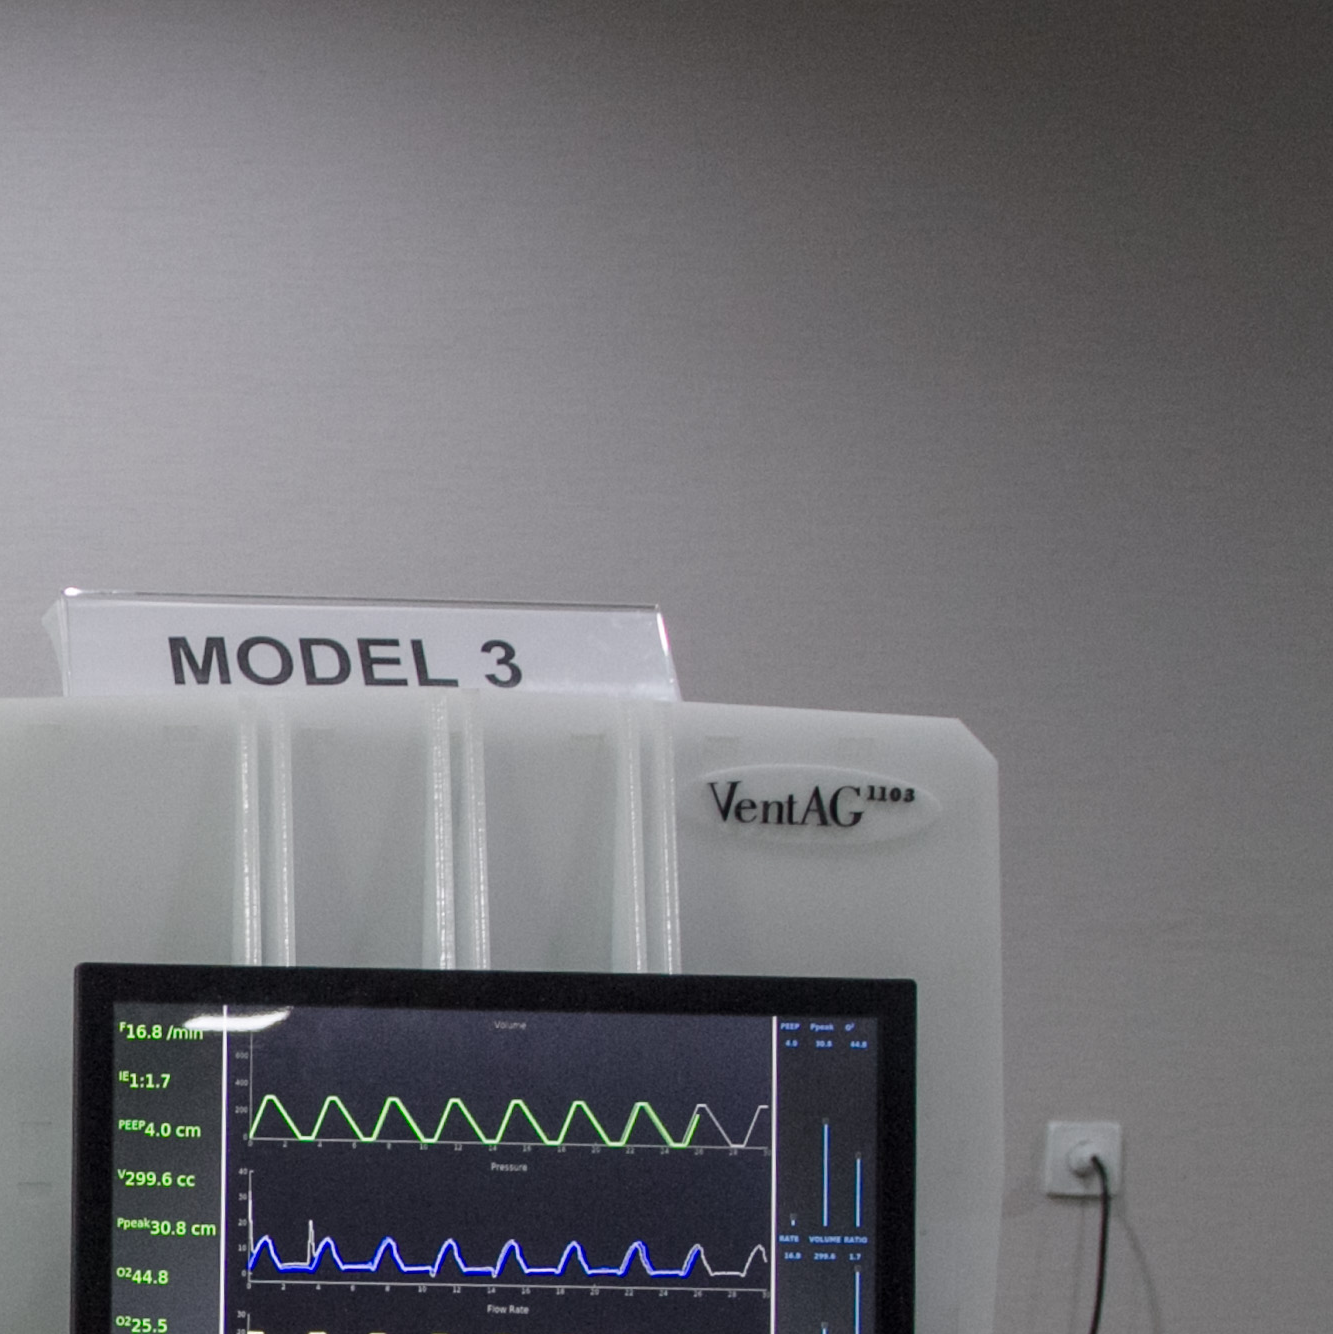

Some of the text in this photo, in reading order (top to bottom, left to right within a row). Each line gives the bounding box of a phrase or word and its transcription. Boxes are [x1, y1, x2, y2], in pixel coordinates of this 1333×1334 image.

[167, 636, 523, 689] MODEL 3
[176, 1124, 202, 1138] cm
[490, 1161, 528, 1172] Pressure
[176, 1174, 196, 1187] cc
[191, 1223, 217, 1236] cm
[487, 1304, 530, 1314] Flow Rate
